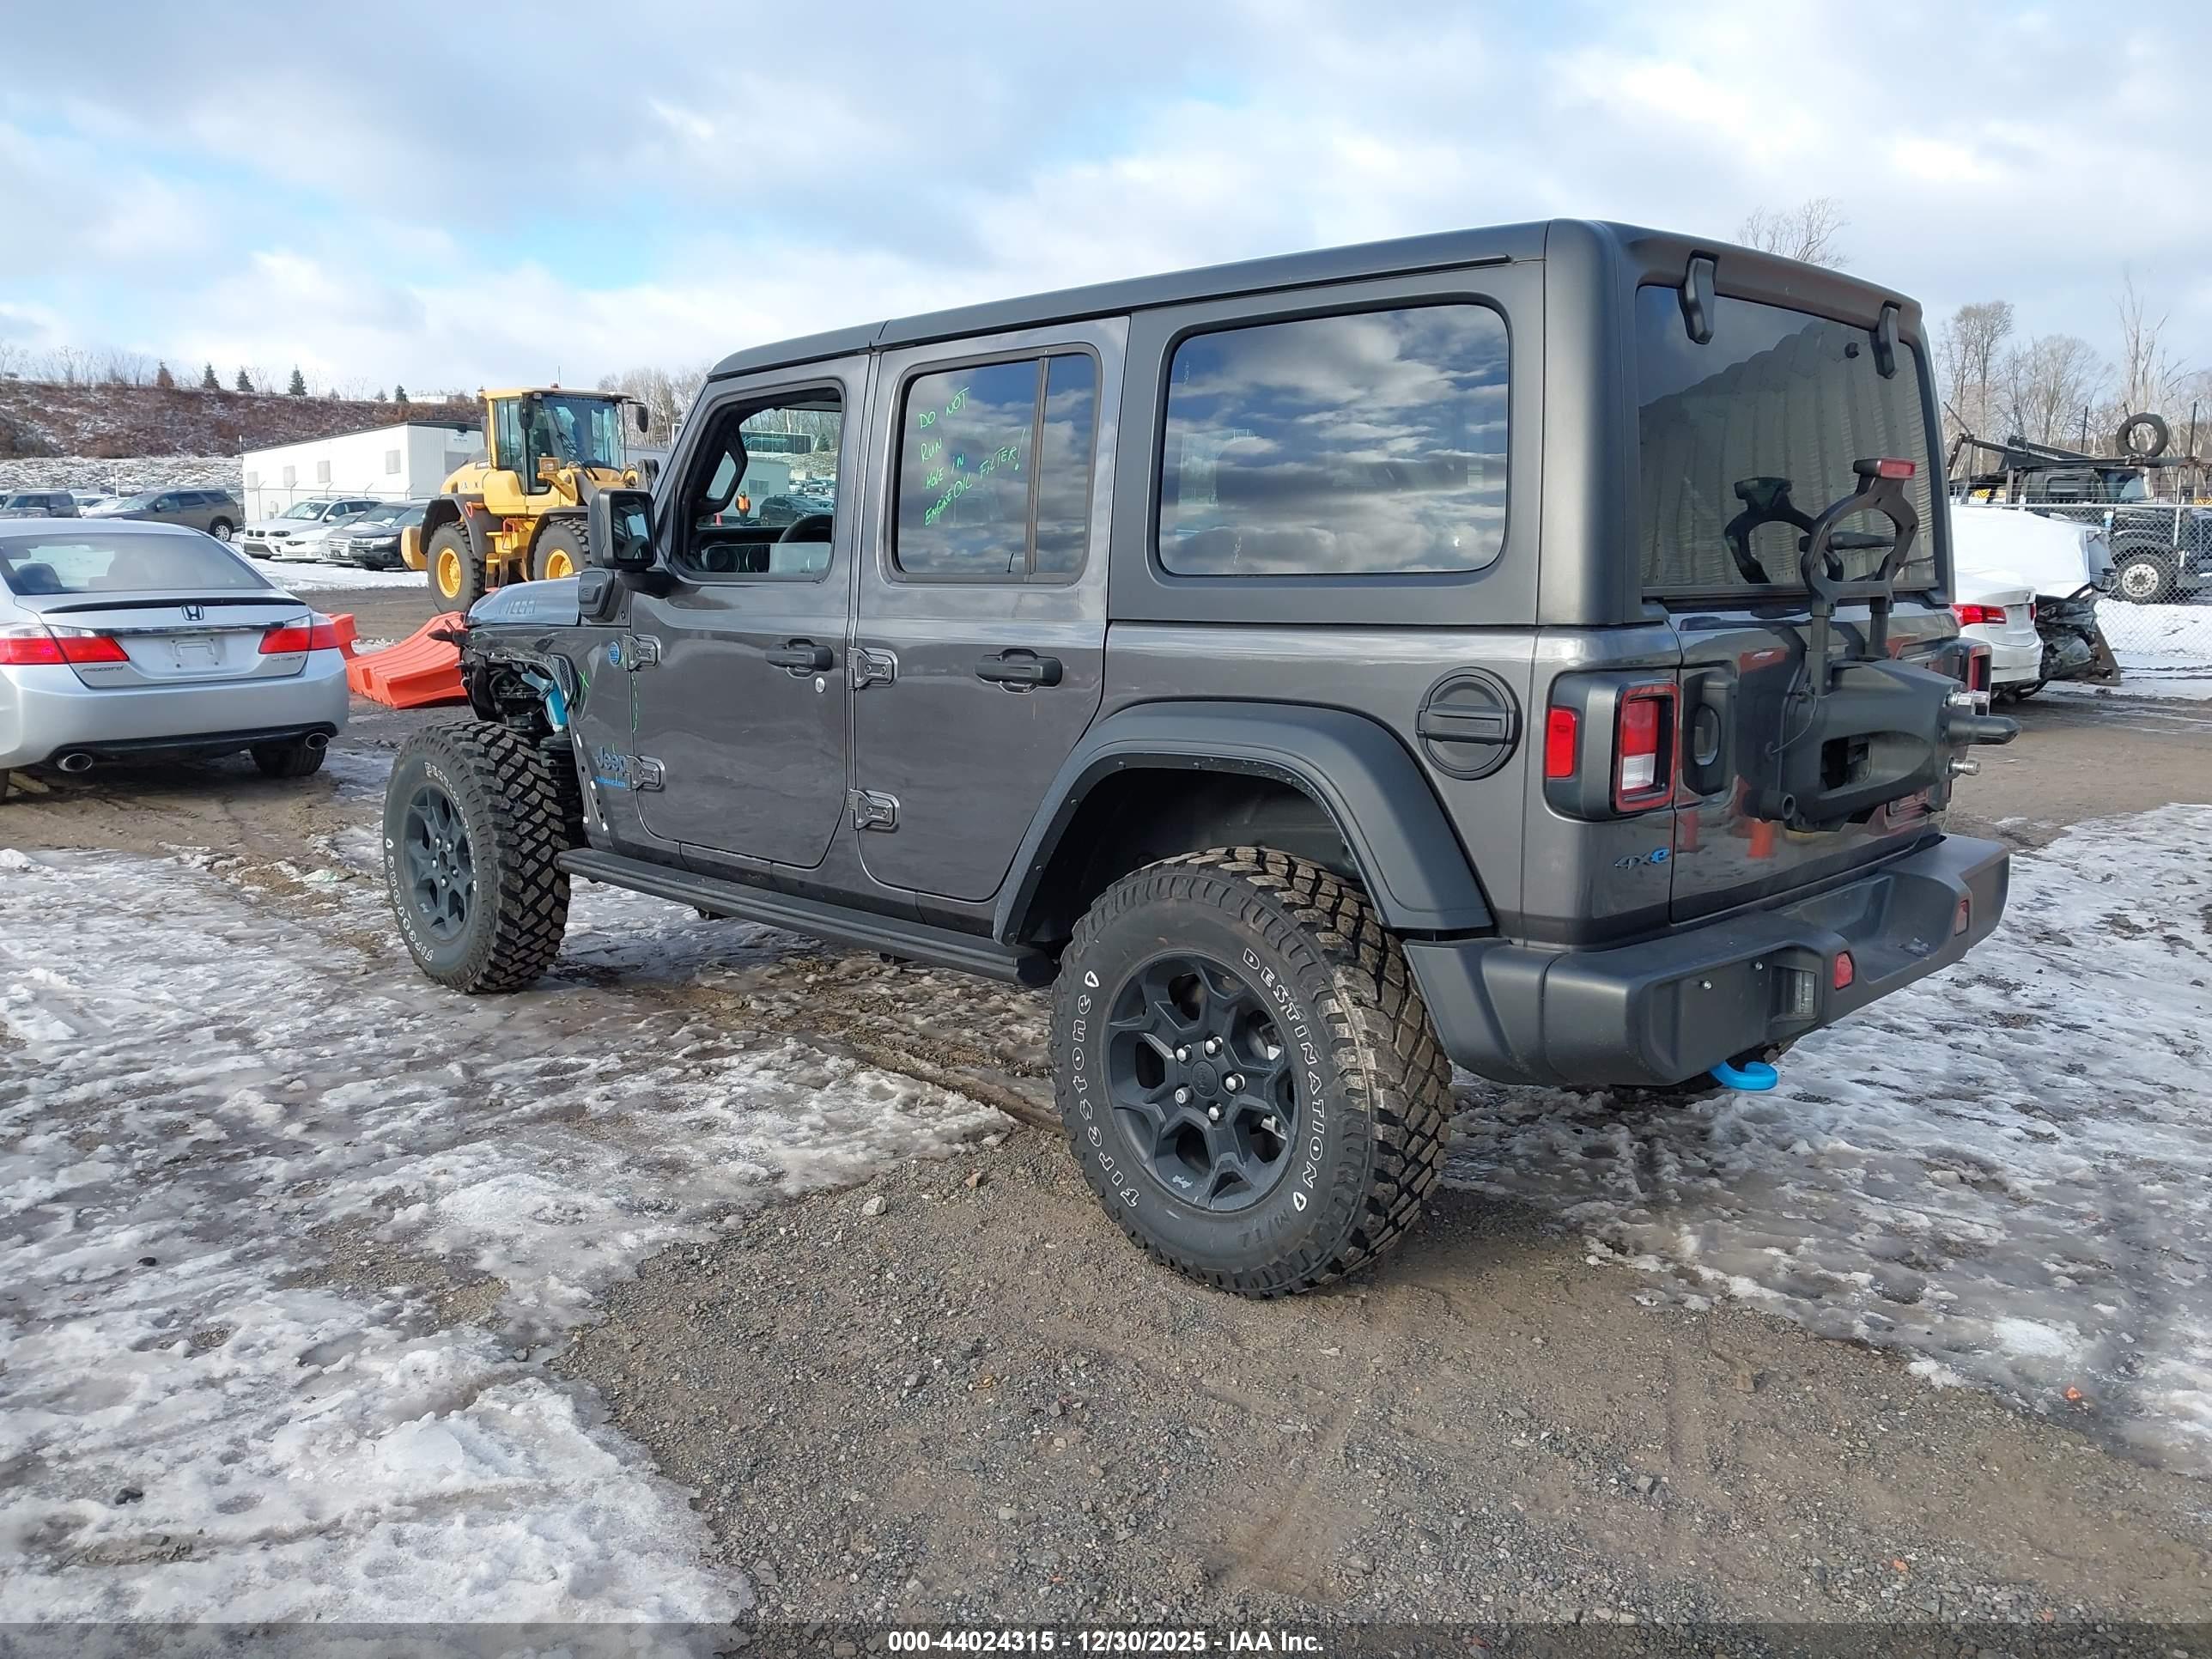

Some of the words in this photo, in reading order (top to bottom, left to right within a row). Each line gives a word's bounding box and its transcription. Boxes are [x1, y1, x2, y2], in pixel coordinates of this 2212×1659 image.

[919, 410, 936, 429] DO
[945, 386, 969, 417] NOT
[81, 665, 125, 673] Accord
[594, 746, 627, 776] Jeep
[1242, 946, 1327, 1190] DESTINATION
